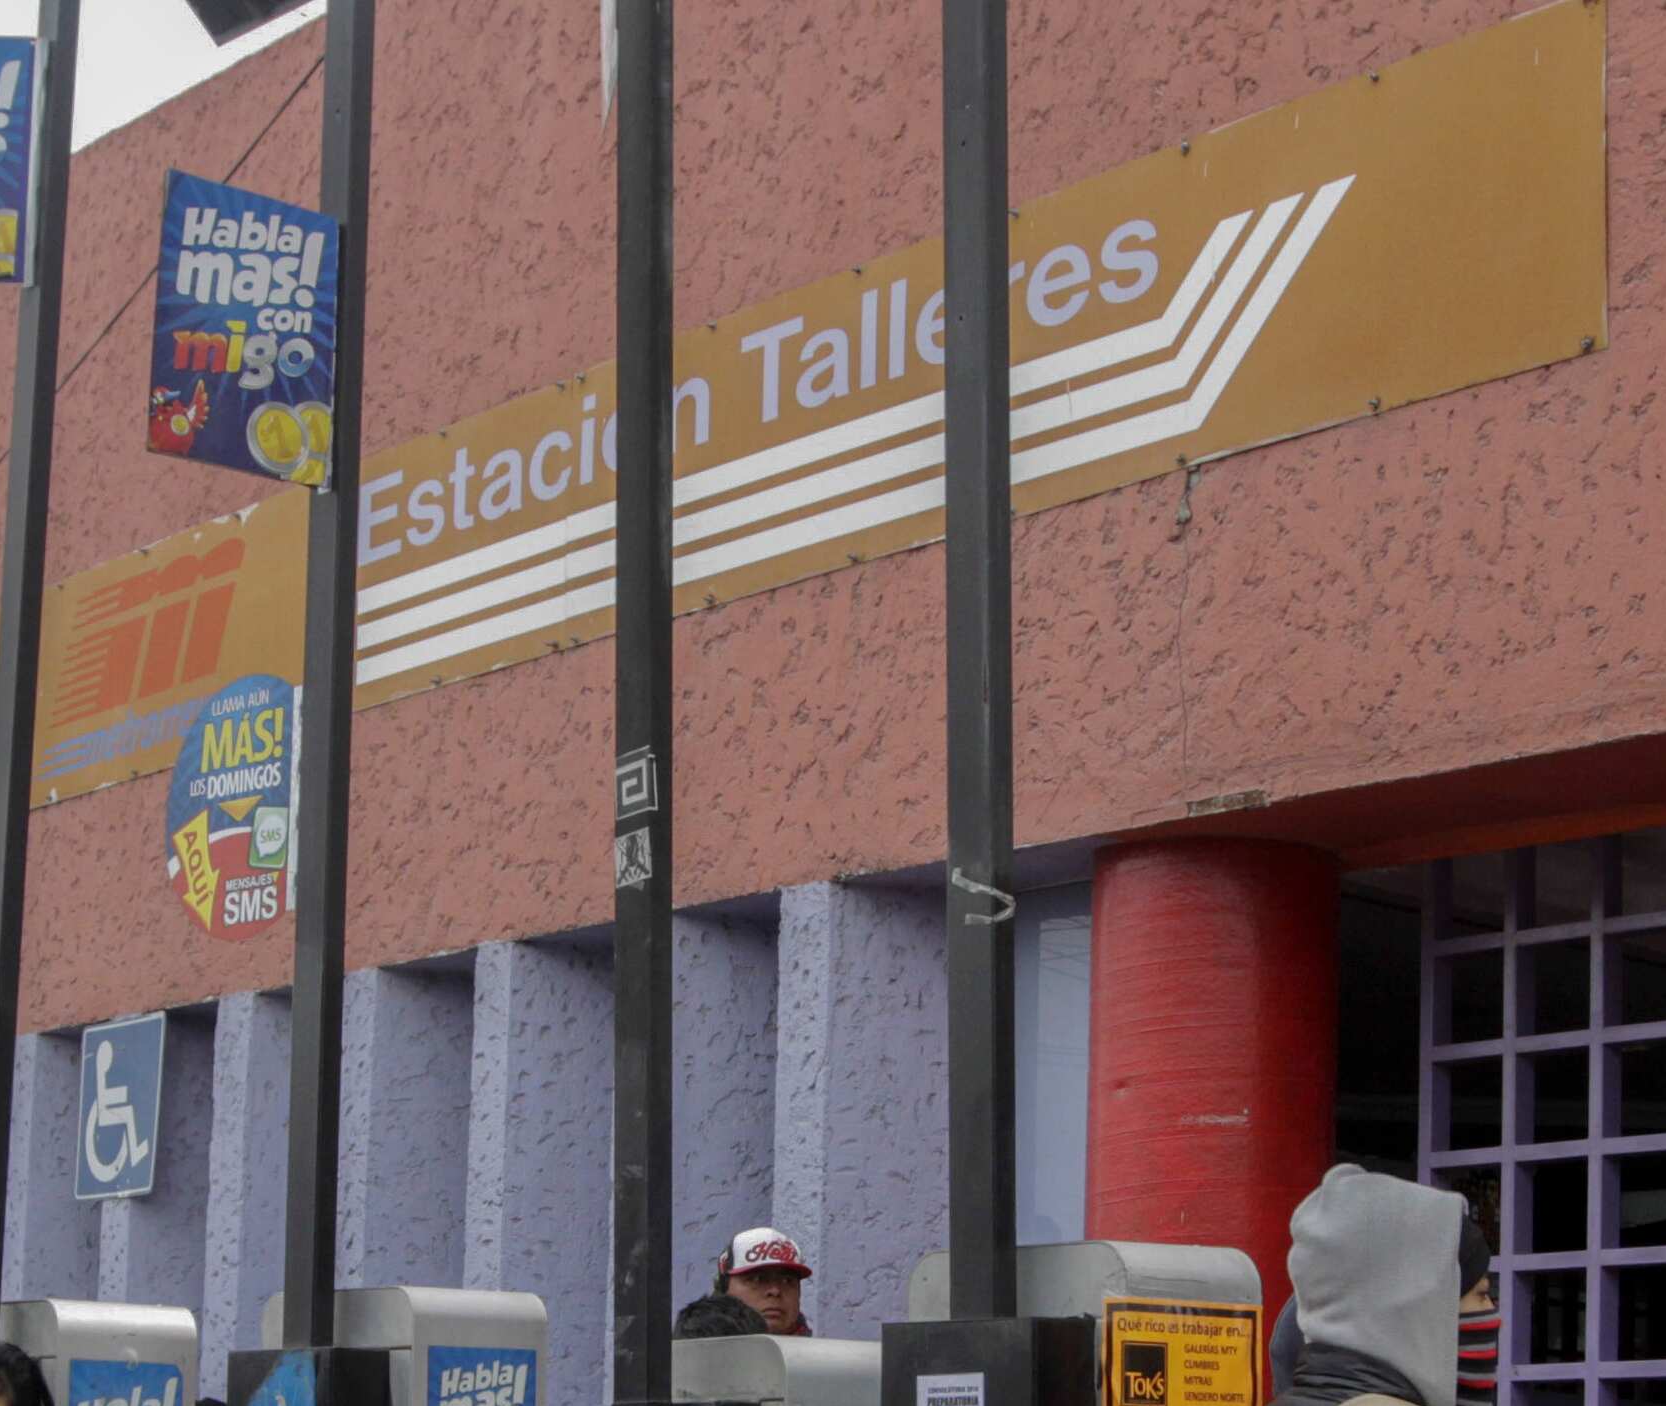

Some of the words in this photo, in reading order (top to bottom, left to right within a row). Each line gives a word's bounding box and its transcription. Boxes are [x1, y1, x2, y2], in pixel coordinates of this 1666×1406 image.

[182, 207, 303, 252] Habla
[175, 231, 325, 308] mas!
[256, 307, 313, 334] con
[173, 319, 315, 391] migo
[357, 378, 710, 567] Estacin
[212, 696, 245, 717] LLAMA
[200, 708, 285, 774] MÁS!
[190, 779, 205, 797] LOS
[207, 763, 281, 799] DOMINGOS
[225, 874, 273, 890] MENSAJES
[224, 885, 278, 926] SMS
[1117, 1318, 1142, 1332] Qué
[1145, 1320, 1165, 1333] rico
[1183, 1321, 1223, 1339] trabajar
[441, 1360, 514, 1398] Habla
[1184, 1360, 1220, 1371] CUMBRES
